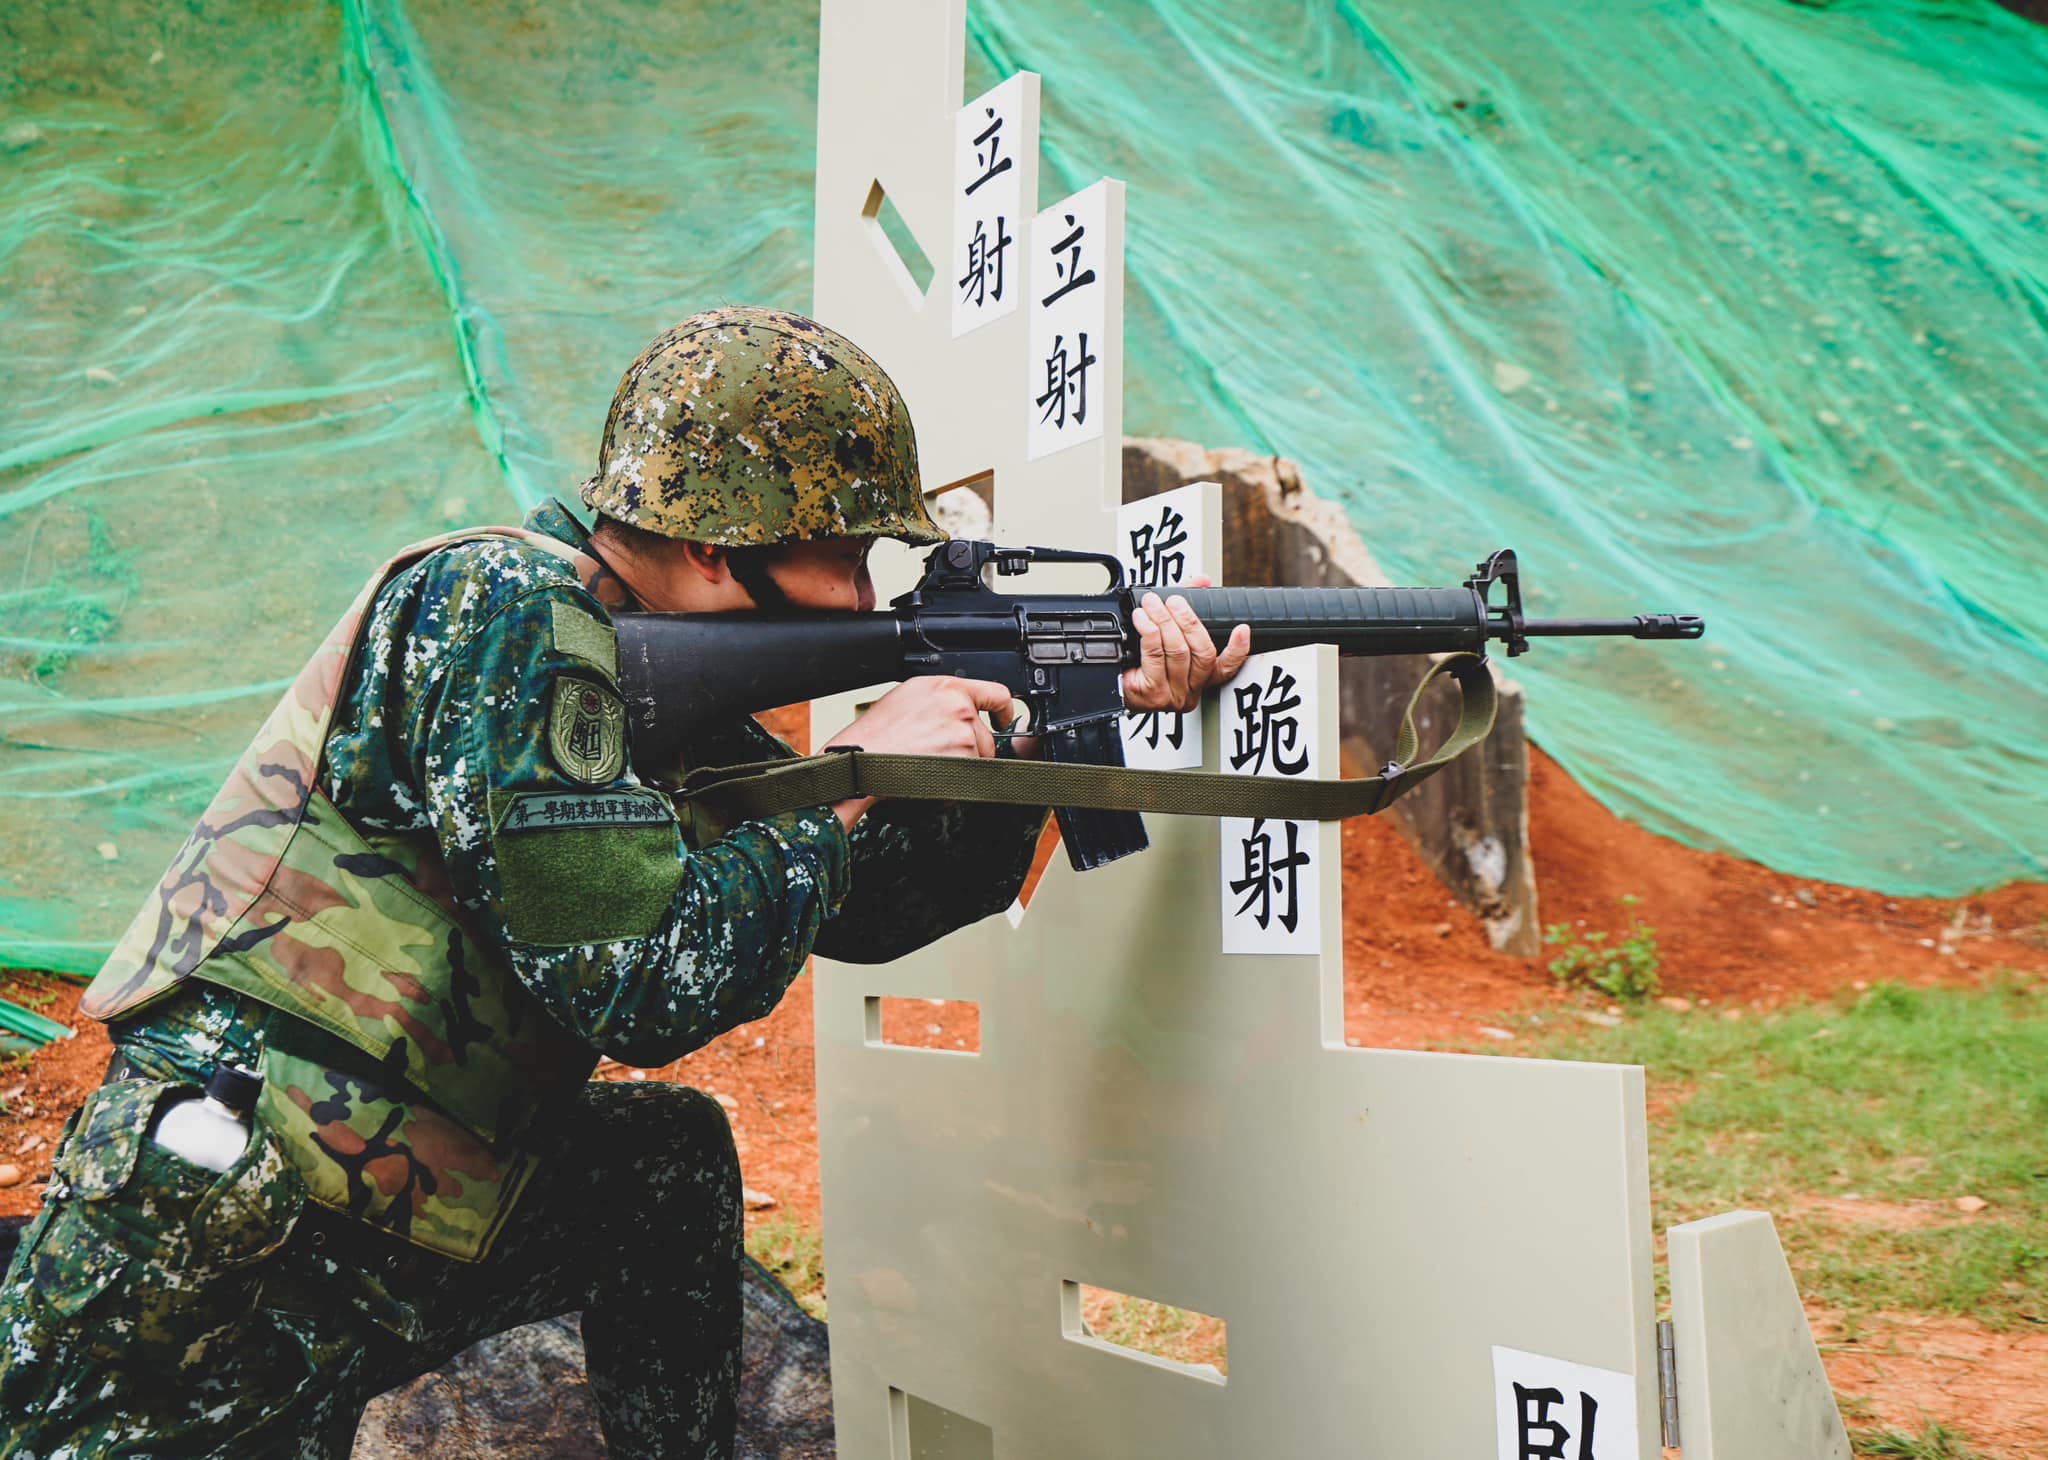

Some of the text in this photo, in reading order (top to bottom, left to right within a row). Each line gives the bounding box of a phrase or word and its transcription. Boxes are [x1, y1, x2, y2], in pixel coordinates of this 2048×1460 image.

[959, 108, 1012, 307] 立射
[1036, 214, 1096, 430] 立射
[1229, 665, 1311, 934] 跪射
